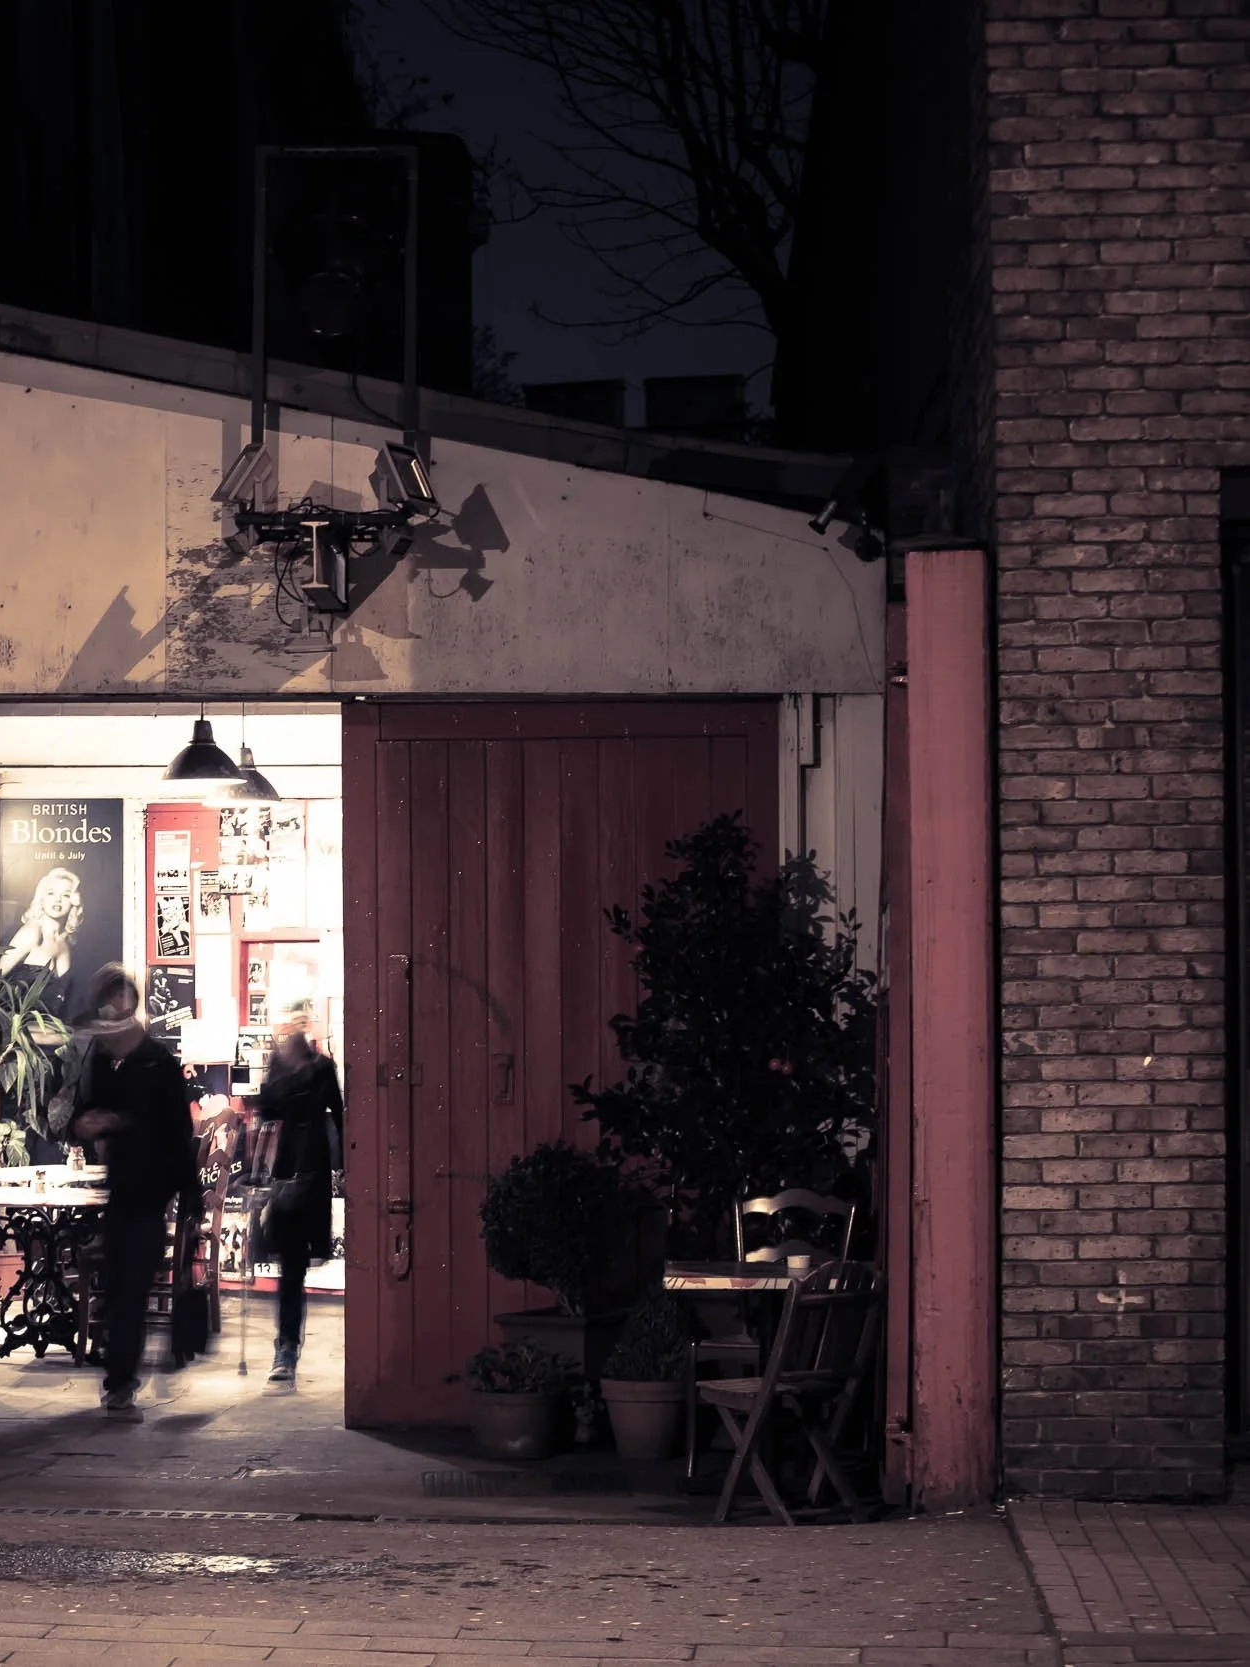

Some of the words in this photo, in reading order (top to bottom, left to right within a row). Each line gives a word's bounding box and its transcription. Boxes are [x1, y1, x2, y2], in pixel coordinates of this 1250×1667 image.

[33, 804, 87, 816] BRITISH
[10, 818, 112, 844] Blondes
[35, 850, 56, 860] Until
[59, 851, 65, 860] 6
[68, 850, 85, 861] July
